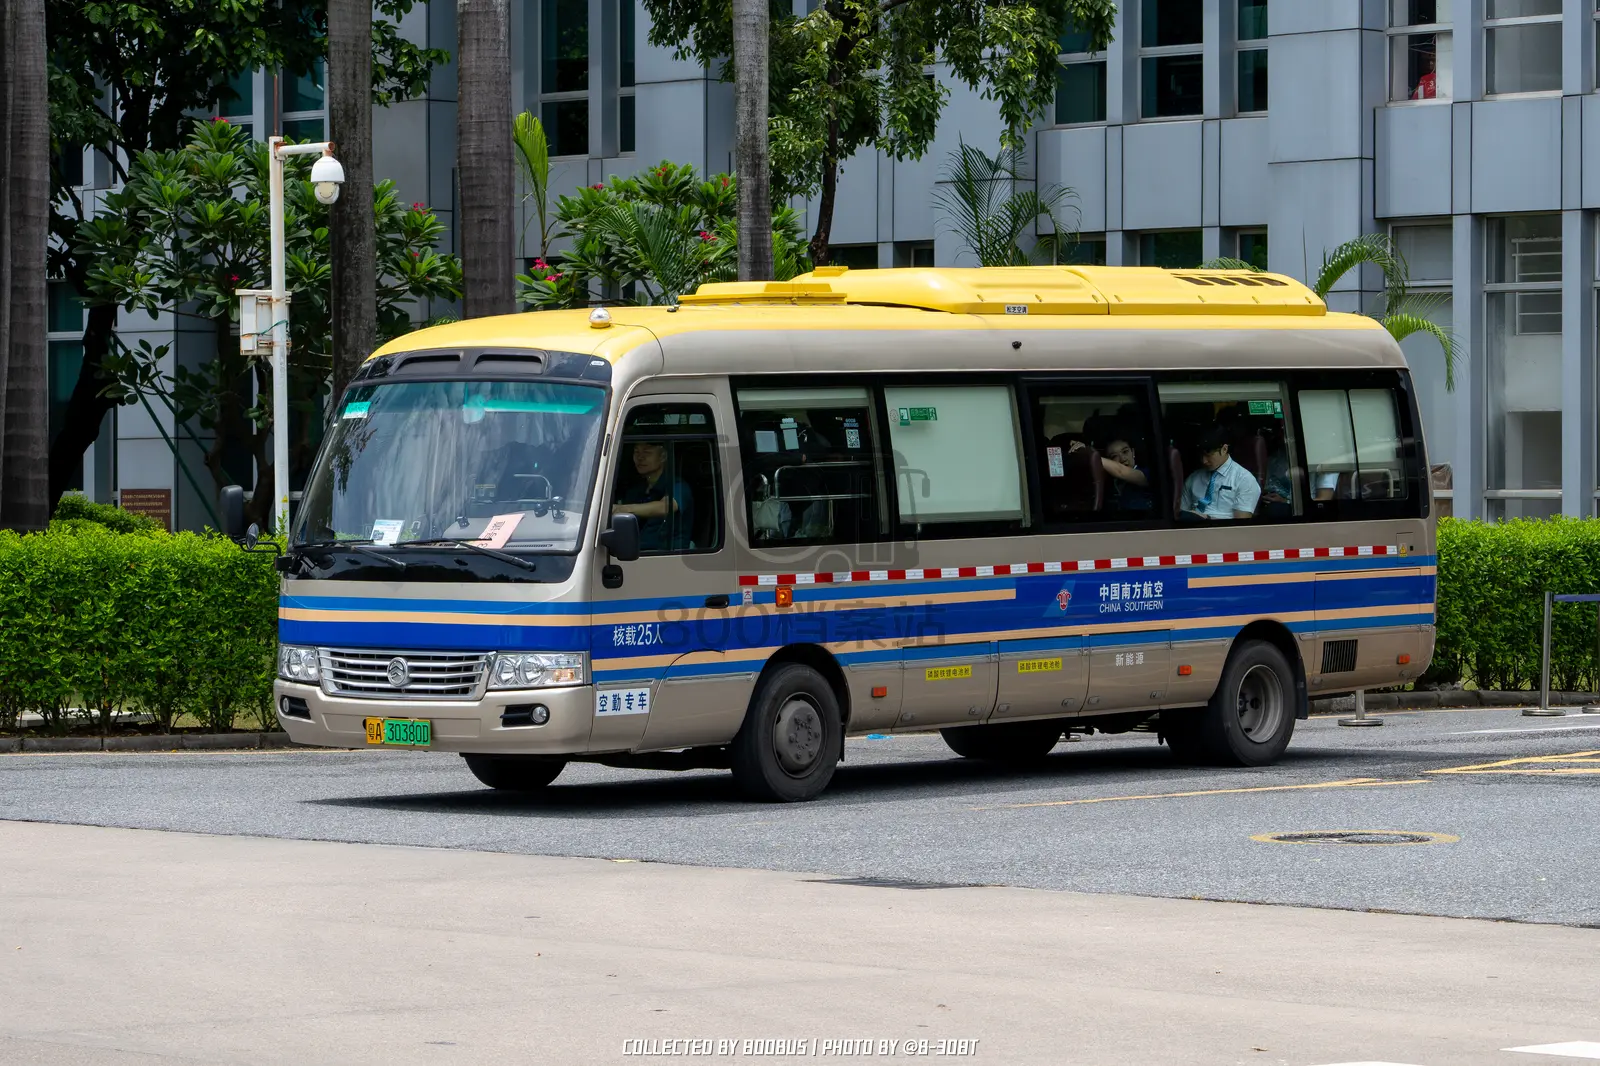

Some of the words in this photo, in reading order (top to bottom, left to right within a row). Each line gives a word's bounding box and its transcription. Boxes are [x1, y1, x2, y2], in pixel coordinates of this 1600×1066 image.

[1099, 581, 1164, 601] 中国南方航空
[1099, 603, 1121, 613] CHINA
[1124, 600, 1164, 612] SOUTHERN
[613, 623, 663, 647] 核载25人
[1115, 651, 1144, 667] 新能源
[598, 691, 647, 713] 空勤专车
